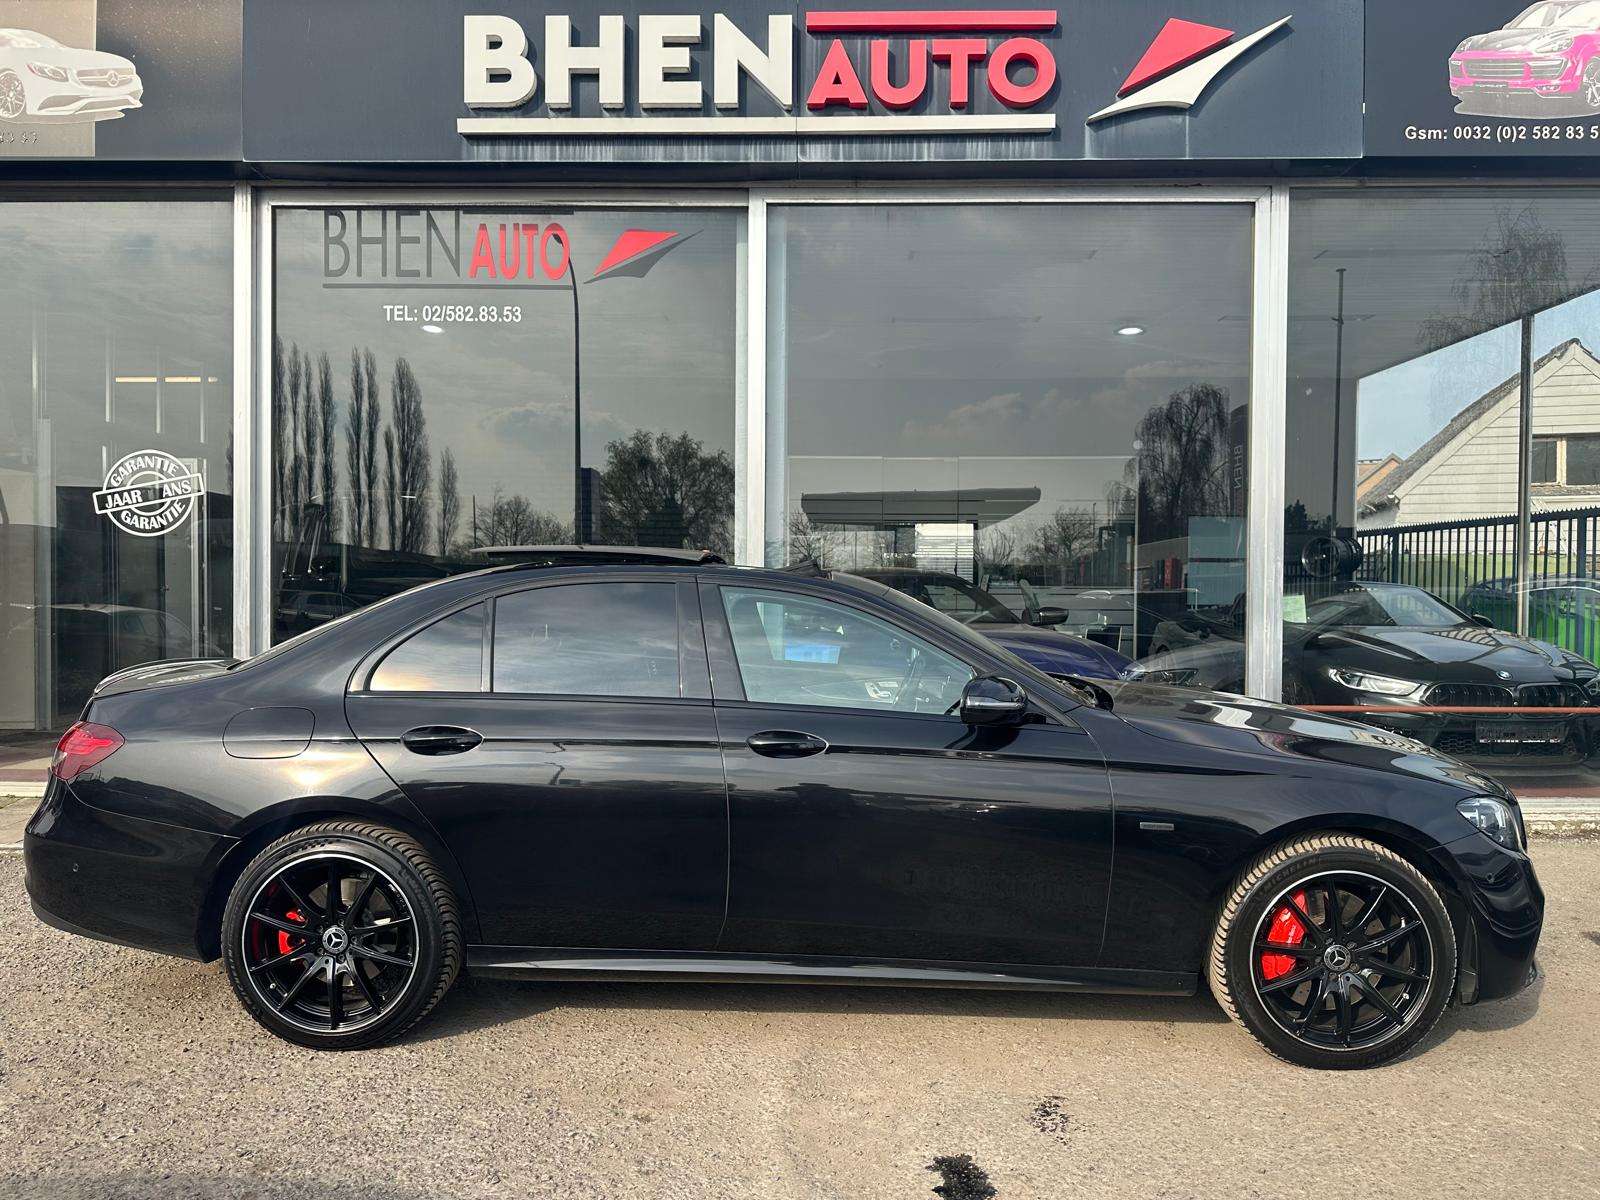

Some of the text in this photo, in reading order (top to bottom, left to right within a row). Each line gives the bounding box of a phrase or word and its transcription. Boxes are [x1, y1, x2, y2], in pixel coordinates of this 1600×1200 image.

[463, 14, 1058, 111] BHEN AUTO
[1404, 125, 1599, 143] Gsm: 0032 (0)2 582 83 5
[323, 207, 570, 280] BHEN AUTO
[382, 304, 522, 323] TEL: 02/582.83.53
[110, 456, 179, 487] GARANTIE
[105, 479, 193, 509] JAAR ANS
[120, 499, 186, 530] GARANTIE
